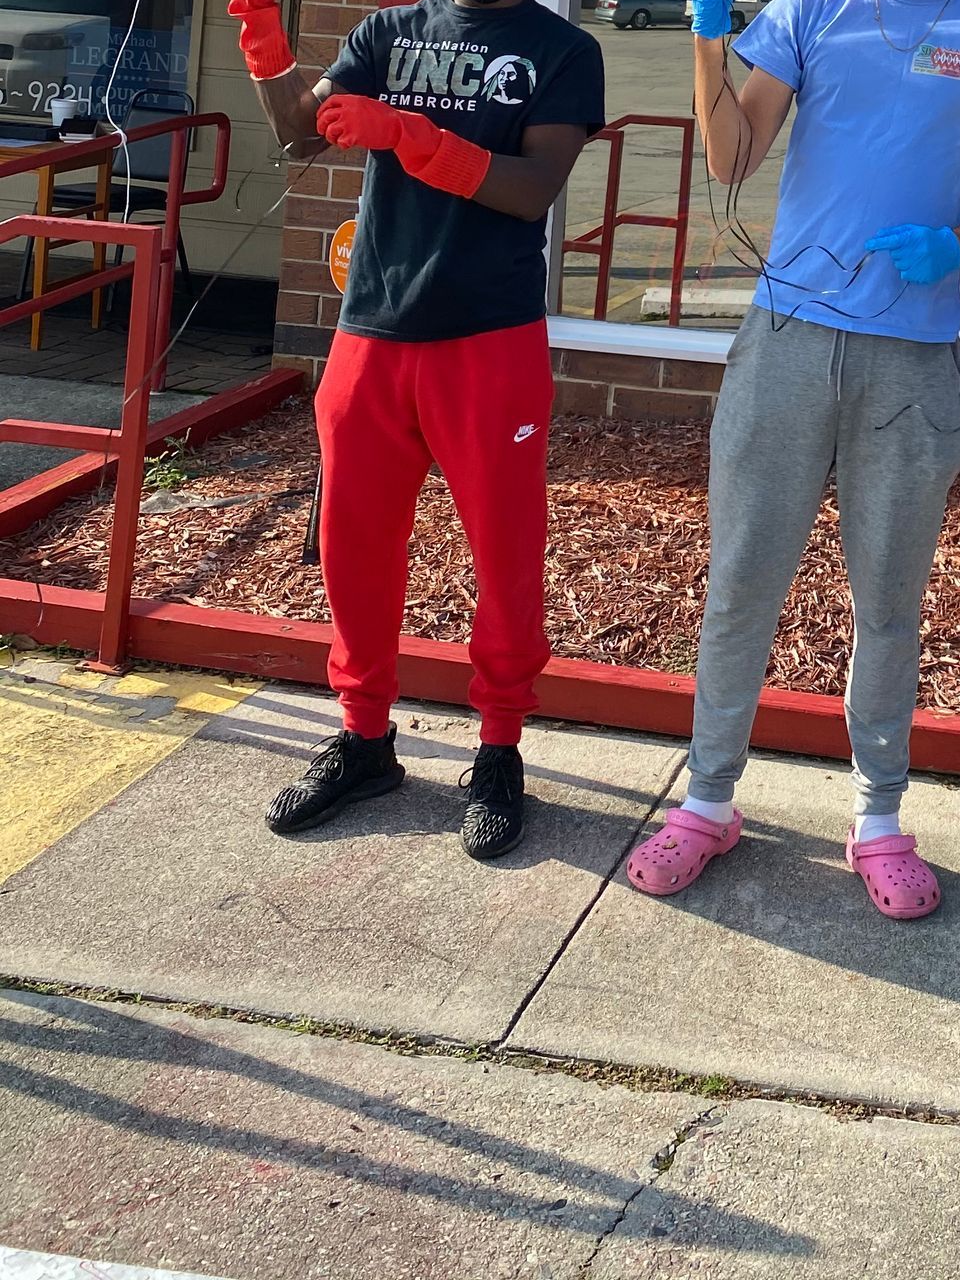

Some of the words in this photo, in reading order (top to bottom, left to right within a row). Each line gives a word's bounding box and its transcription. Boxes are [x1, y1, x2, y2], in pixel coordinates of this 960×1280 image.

[107, 32, 157, 48] Mihael
[393, 36, 489, 54] #BraveNation
[71, 45, 189, 74] LEGRAND
[385, 46, 485, 97] UNC
[379, 93, 477, 112] PEMBROKE
